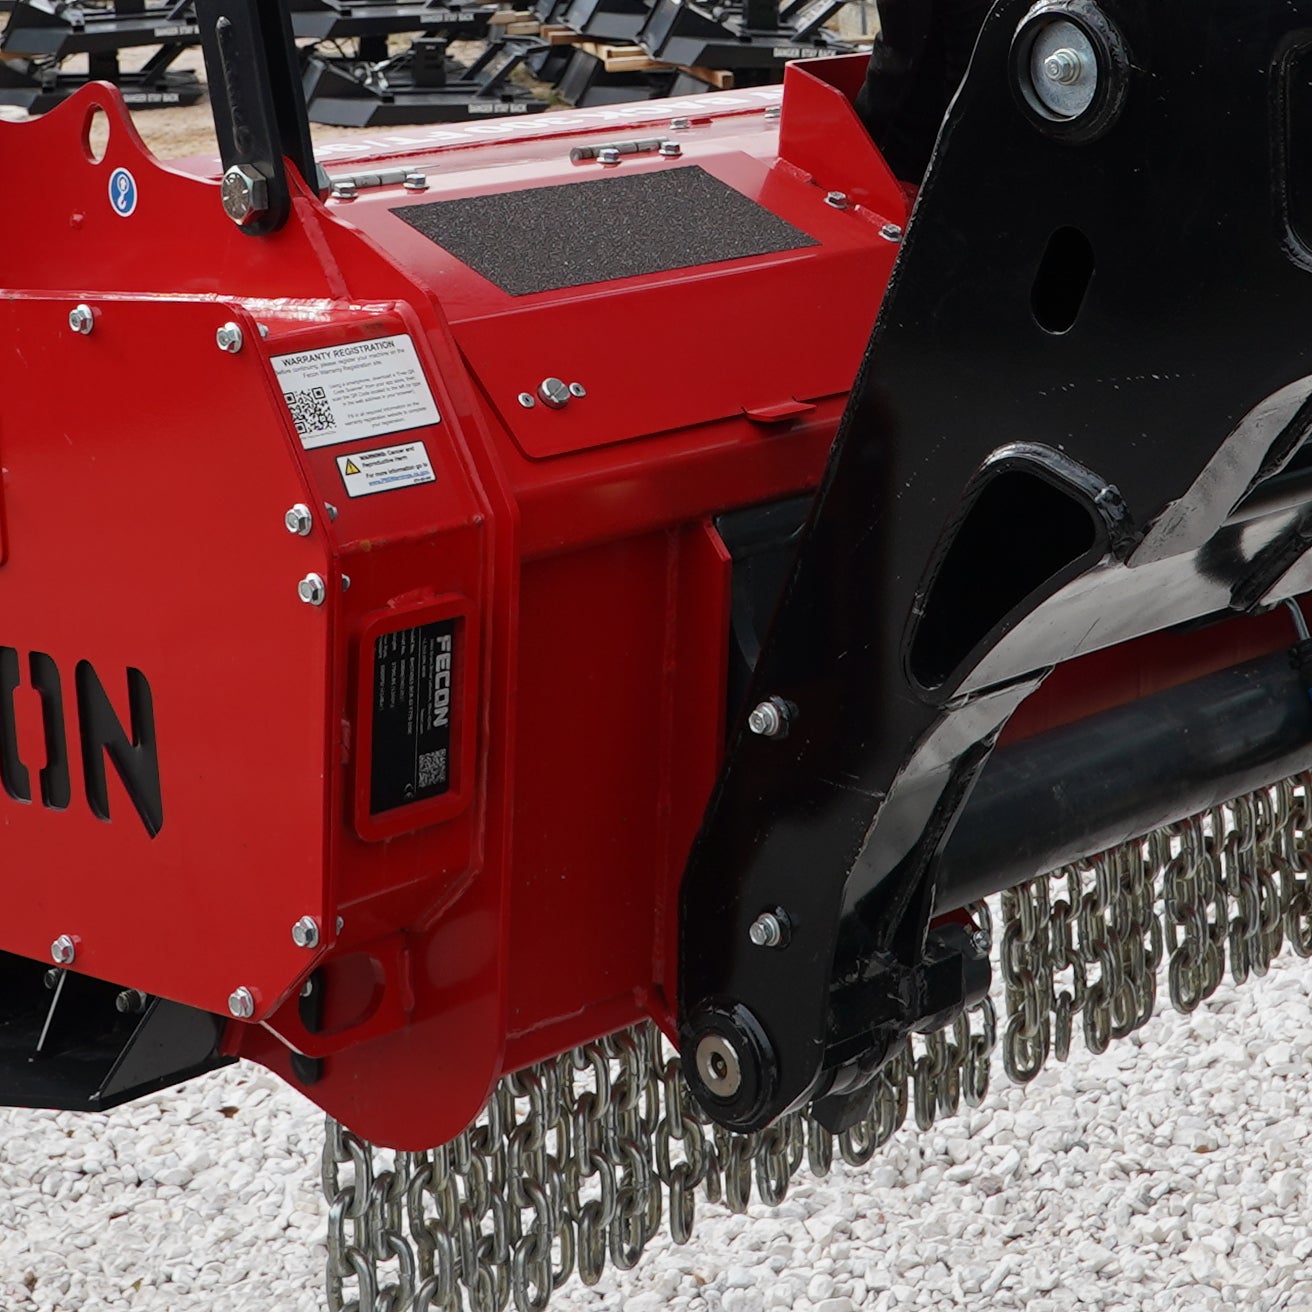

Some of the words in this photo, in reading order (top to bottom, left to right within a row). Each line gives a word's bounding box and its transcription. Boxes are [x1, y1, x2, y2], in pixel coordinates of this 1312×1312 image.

[572, 97, 751, 120] BACK
[282, 351, 331, 367] WARRANTY
[333, 340, 395, 358] REGISTRATION
[432, 634, 452, 727] FECON
